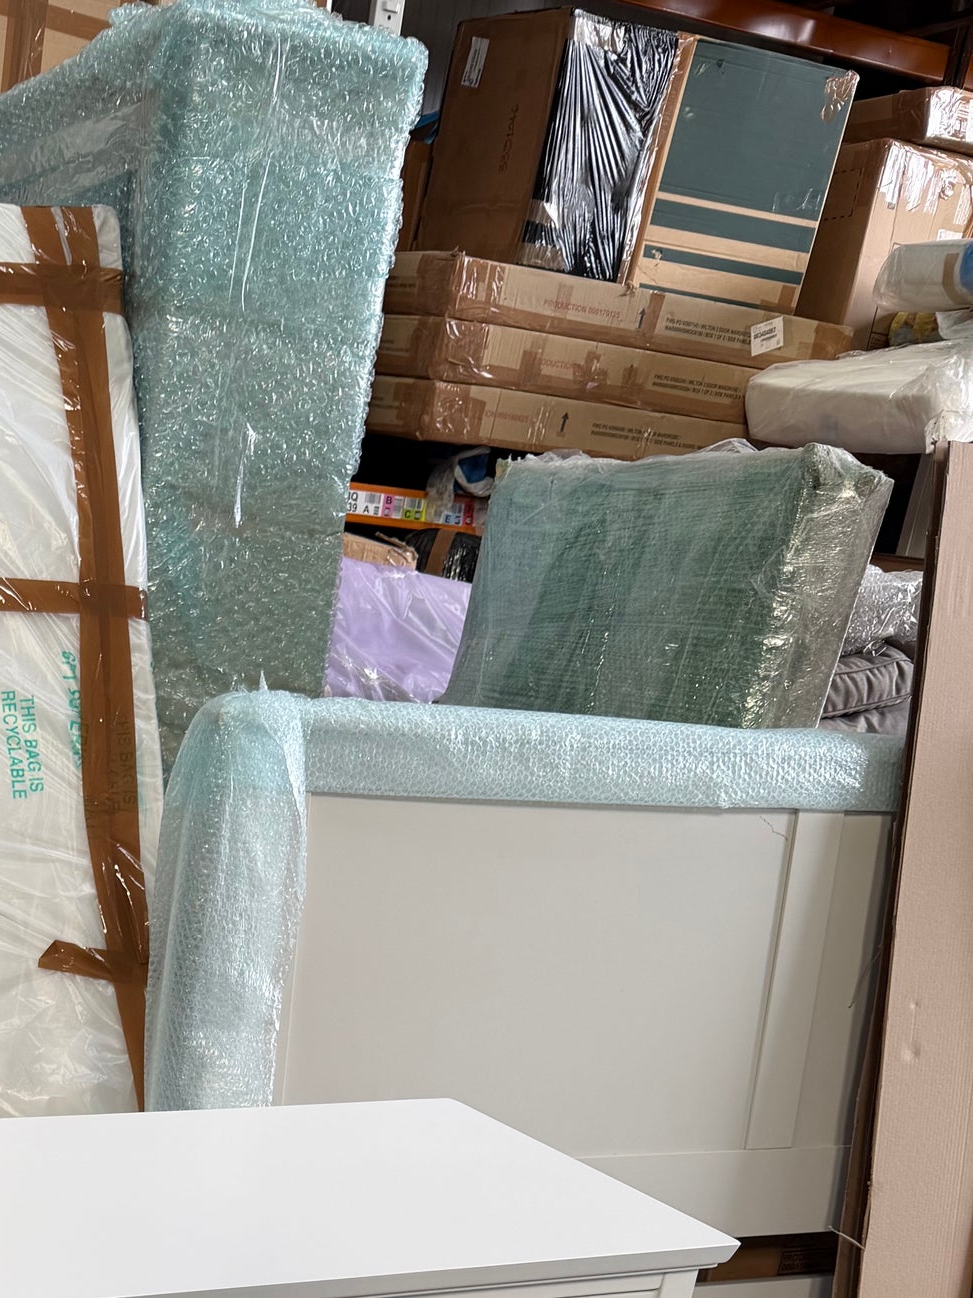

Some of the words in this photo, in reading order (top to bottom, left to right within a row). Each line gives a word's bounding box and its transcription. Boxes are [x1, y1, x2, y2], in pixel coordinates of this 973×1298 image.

[385, 496, 393, 504] B
[404, 510, 411, 518] C
[19, 695, 37, 733] THIS
[1, 690, 28, 800] RECYCLABLE
[24, 739, 42, 777] BAG
[29, 778, 44, 793] IS
